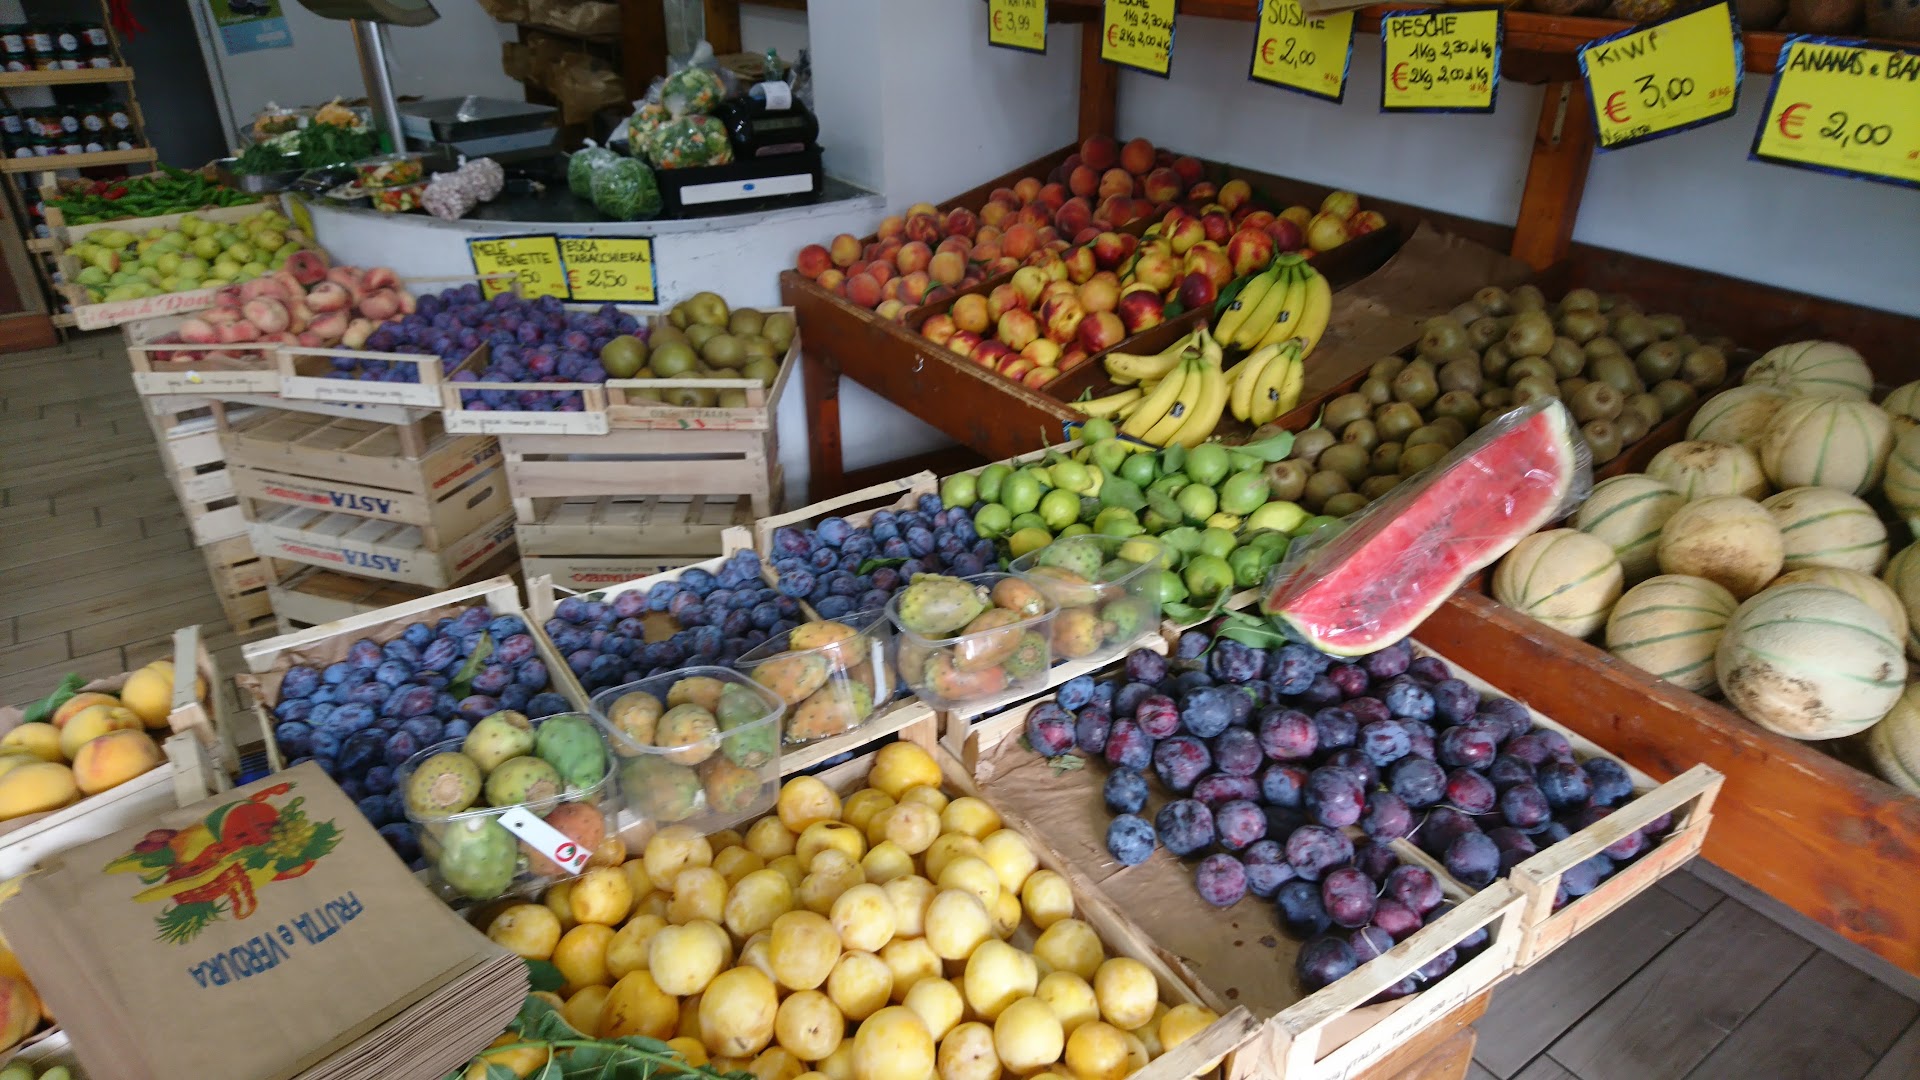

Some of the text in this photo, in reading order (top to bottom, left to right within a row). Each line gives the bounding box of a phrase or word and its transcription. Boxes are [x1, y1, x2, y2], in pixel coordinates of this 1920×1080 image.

[993, 9, 1030, 34] € 3,99
[1392, 16, 1458, 38] PESCHE
[1107, 23, 1119, 48] €
[1262, 37, 1316, 69] € 2,00
[1790, 48, 1865, 76] ANANAS
[1392, 62, 1409, 91] €
[1604, 73, 1695, 123] € 3,00
[1776, 102, 1892, 148] € 2,00
[586, 269, 627, 290] 2,50
[329, 491, 391, 514] ASTA
[342, 549, 401, 573] ASTA
[187, 890, 364, 988] FRUTTA e VERDURA
